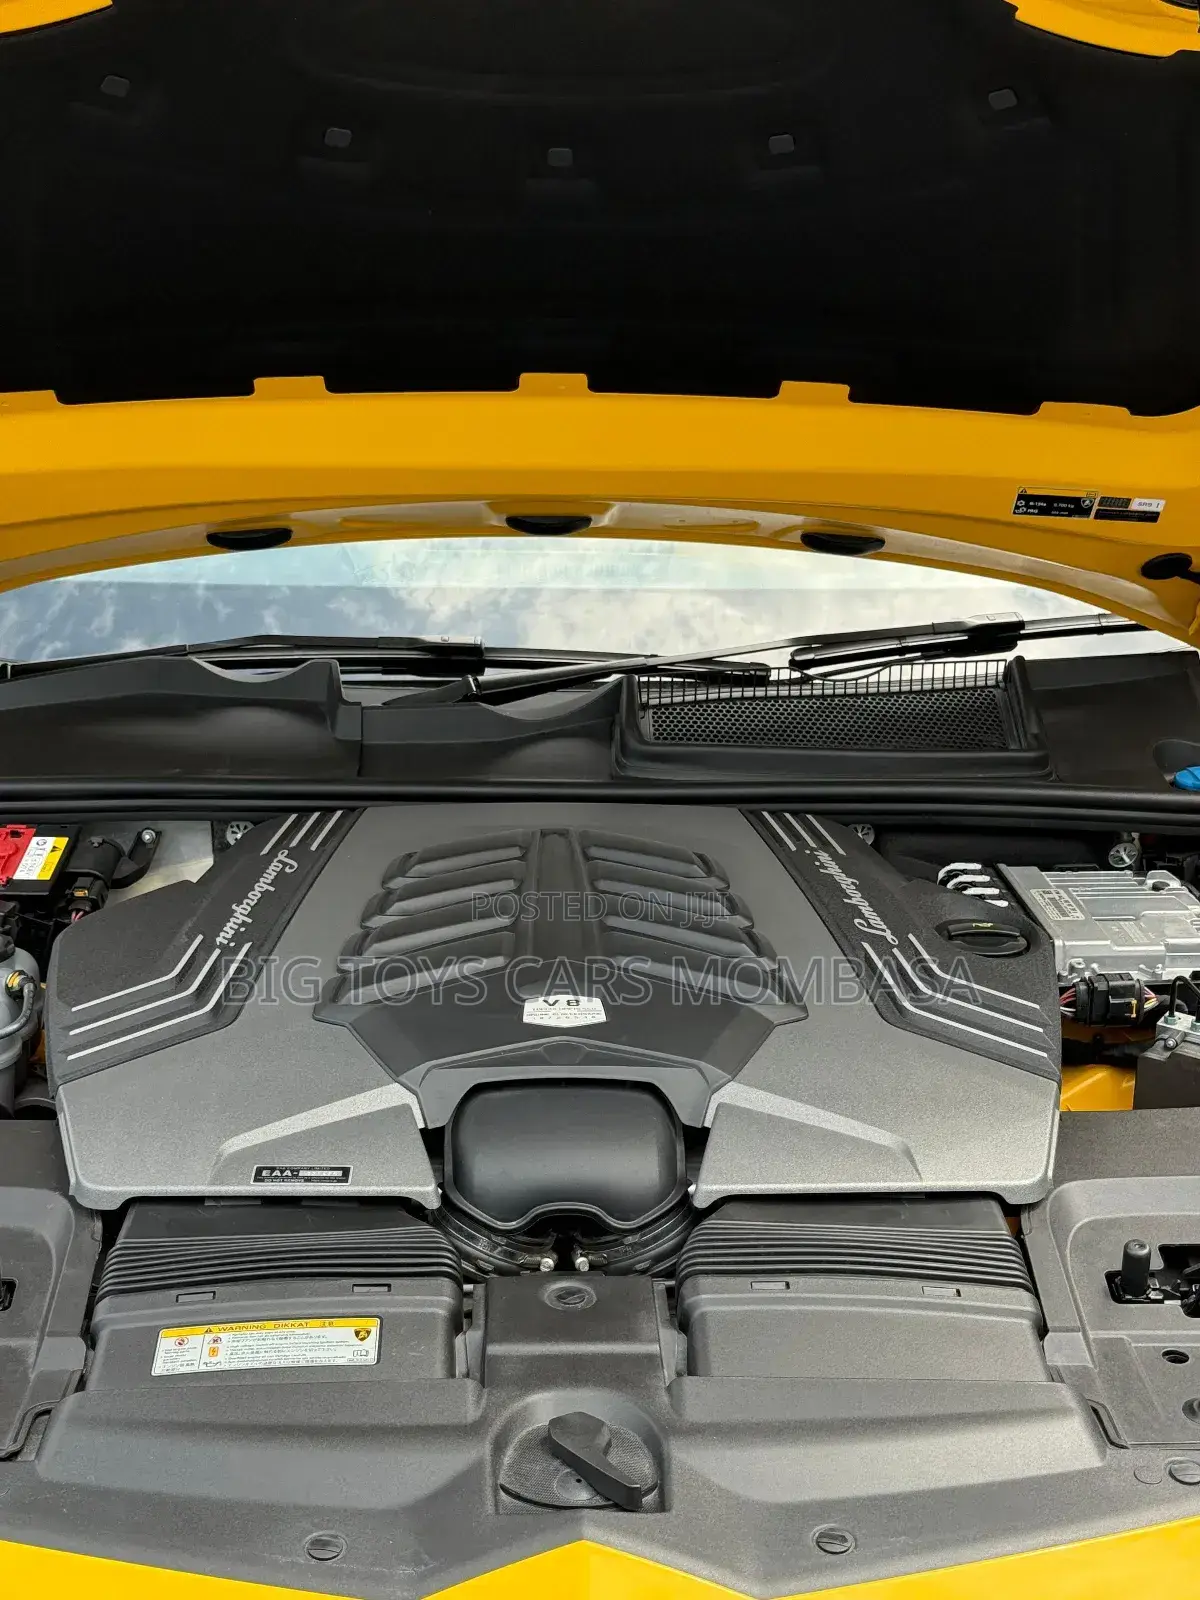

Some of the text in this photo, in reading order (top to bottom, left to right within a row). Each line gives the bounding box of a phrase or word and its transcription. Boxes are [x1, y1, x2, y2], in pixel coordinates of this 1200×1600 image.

[215, 848, 299, 948] Lamborghini
[804, 848, 898, 946] Lamborghini
[217, 1321, 310, 1332] WARNING DIKKAT
